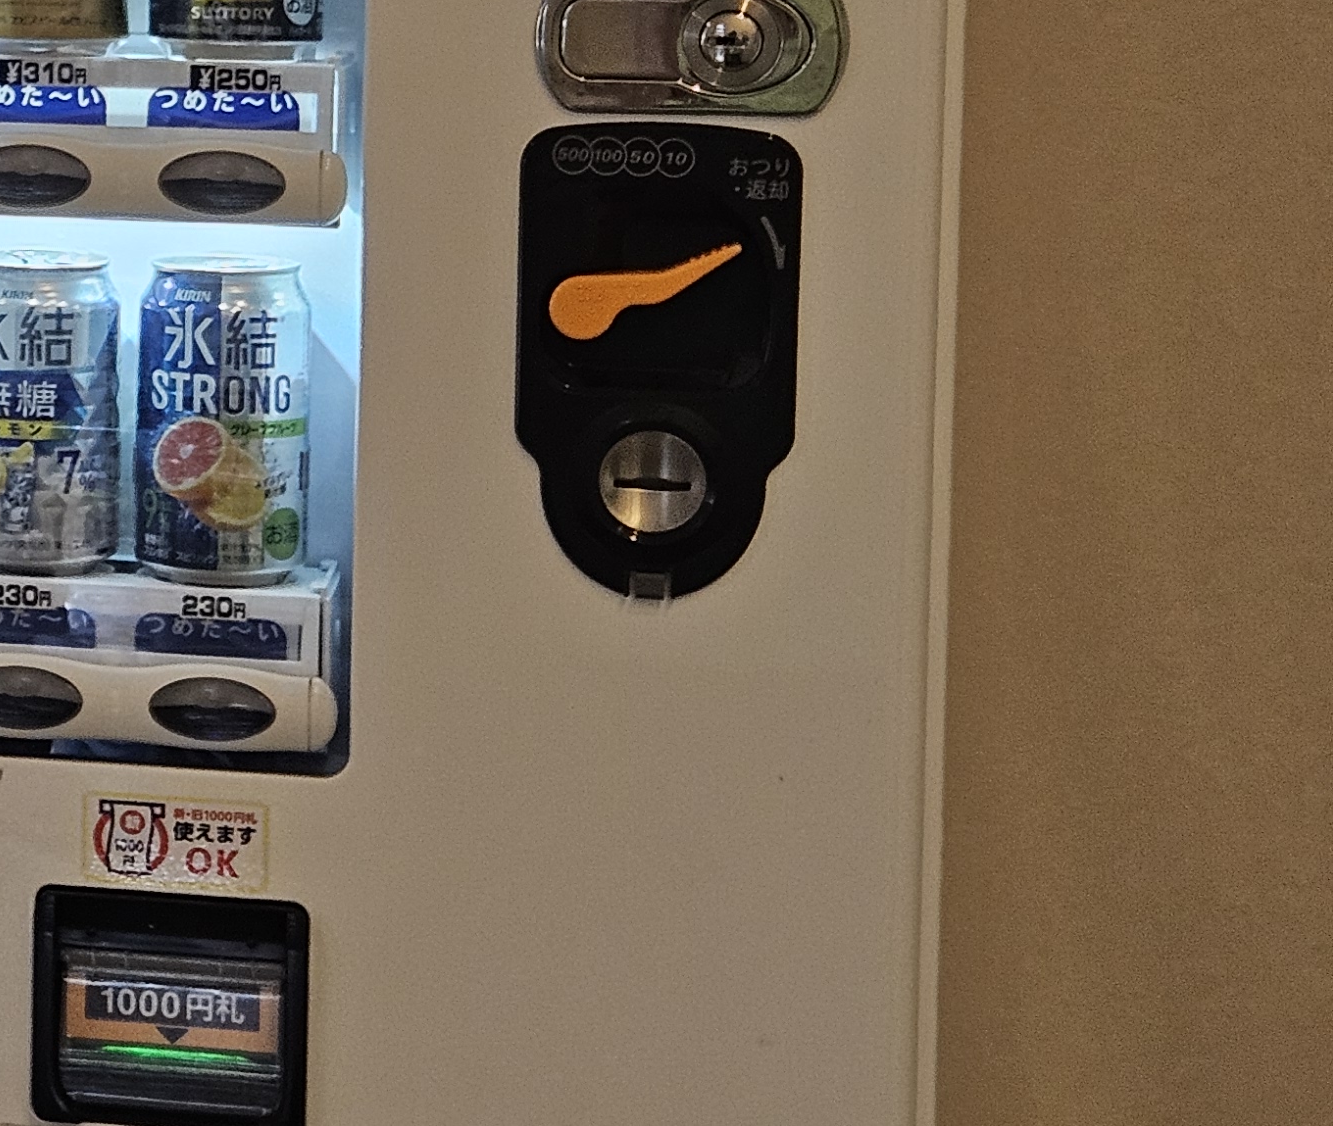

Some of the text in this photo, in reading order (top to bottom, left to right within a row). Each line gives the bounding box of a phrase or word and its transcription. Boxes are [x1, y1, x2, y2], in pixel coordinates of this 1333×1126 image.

[558, 148, 688, 165] 500 100 50 10
[729, 158, 791, 177] おつり
[175, 289, 211, 302] KIRIN
[164, 304, 277, 370] 氷結
[151, 370, 291, 414] STRONG
[182, 595, 247, 619] 230円
[173, 822, 257, 845] 使えます
[185, 847, 240, 879] OK
[101, 987, 245, 1025] 1000円札
